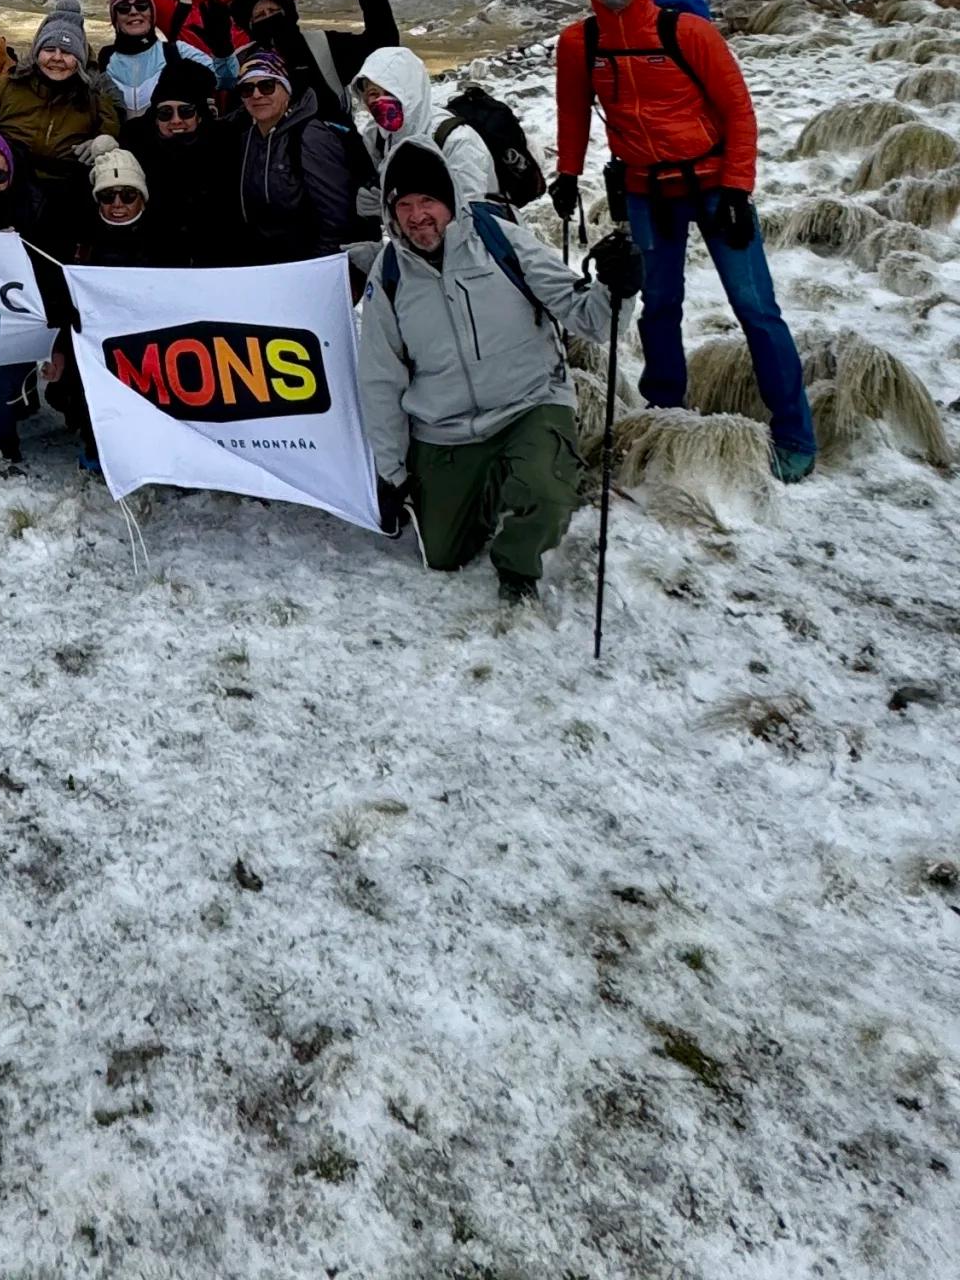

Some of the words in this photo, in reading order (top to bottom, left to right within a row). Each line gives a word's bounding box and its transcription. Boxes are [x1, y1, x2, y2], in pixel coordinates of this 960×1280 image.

[112, 336, 317, 406] MONS
[231, 439, 246, 448] DE
[251, 437, 317, 450] MONTAÑA
